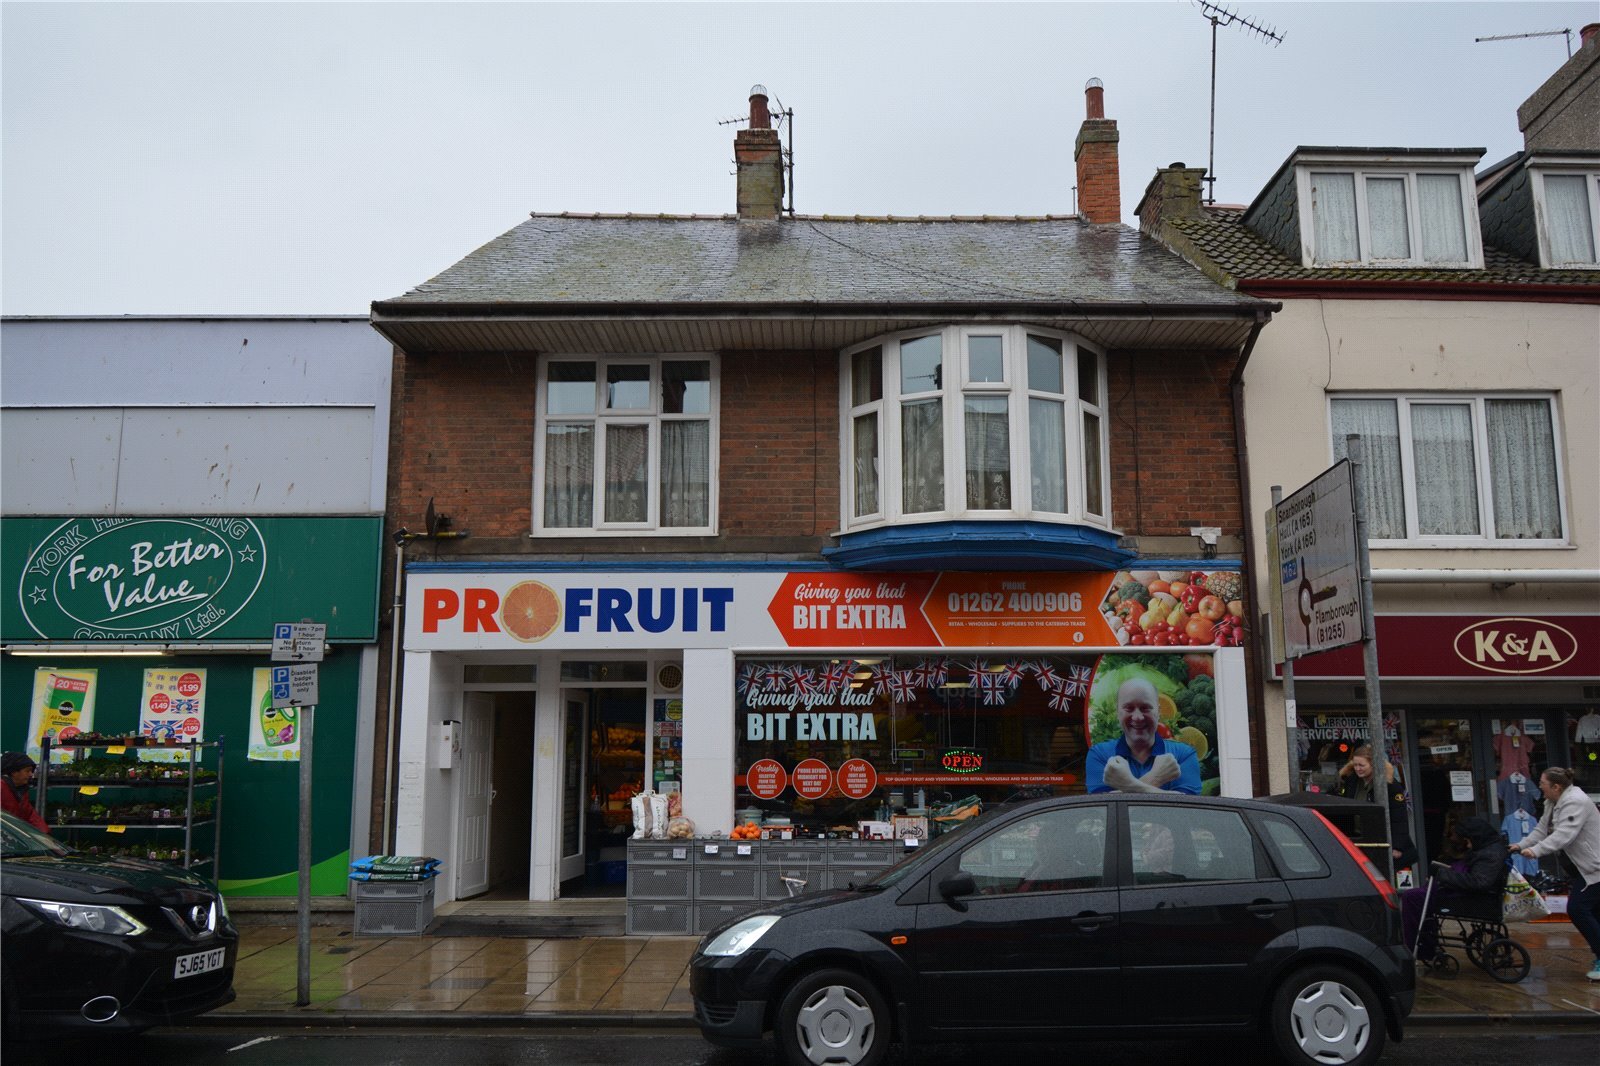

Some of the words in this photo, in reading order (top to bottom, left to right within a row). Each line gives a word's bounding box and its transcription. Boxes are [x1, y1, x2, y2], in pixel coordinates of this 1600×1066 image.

[1279, 490, 1315, 523] Scarborough
[1280, 523, 1291, 541] Hull
[29, 525, 88, 576] YORK
[1281, 543, 1294, 560] York
[68, 554, 124, 590] For
[130, 537, 224, 576] Better
[103, 573, 194, 612] Value
[794, 582, 841, 603] Giving
[844, 587, 872, 603] you
[875, 582, 906, 599] that
[1002, 582, 1026, 590] PHONE
[564, 588, 734, 632] FRUIT
[948, 592, 1004, 612] 01262
[1008, 592, 1082, 612] 400906
[1315, 597, 1358, 624] Flamborough
[185, 603, 226, 636] Ltd.
[793, 605, 831, 629] BIT
[836, 605, 907, 629] EXTRA
[1317, 620, 1345, 645] (B1255)
[1473, 630, 1562, 662] K&A
[746, 687, 798, 711] Giving
[800, 690, 836, 711] you
[839, 686, 875, 706] that
[747, 713, 791, 740] BIT
[796, 713, 877, 740] EXTRA
[1341, 728, 1397, 739] AVAILLE
[755, 764, 779, 774] Freshly
[848, 764, 866, 772] Fresh
[942, 755, 983, 767] OPEN
[180, 954, 205, 974] SJ65
[207, 951, 221, 968] YGT
